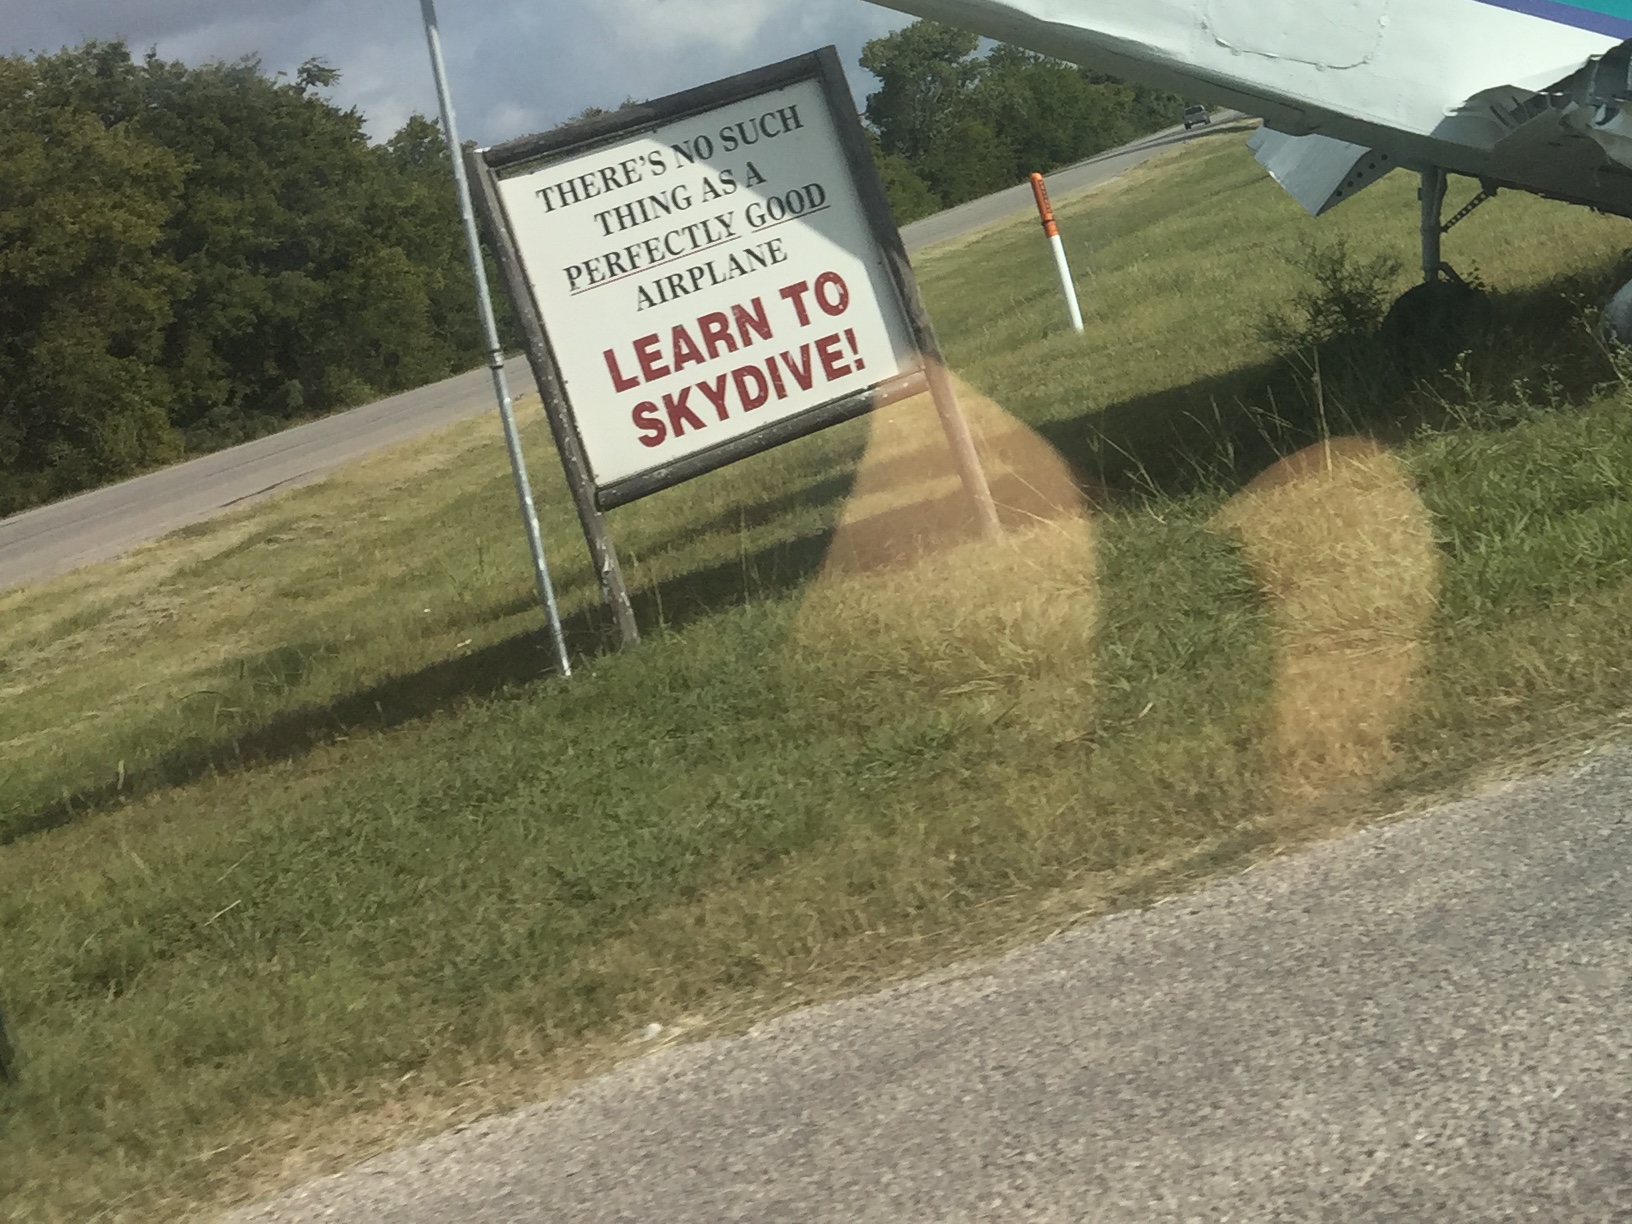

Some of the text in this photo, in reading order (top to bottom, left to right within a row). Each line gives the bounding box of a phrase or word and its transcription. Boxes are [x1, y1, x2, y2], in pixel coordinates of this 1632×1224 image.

[670, 134, 715, 169] NO
[718, 104, 804, 152] SUCH
[563, 182, 827, 292] PERFECTLY GOOD
[594, 161, 767, 238] THING AS A
[635, 237, 789, 312] AIRPLANE
[603, 271, 850, 393] LEARN TO
[631, 327, 866, 448] SKYDIVE!
